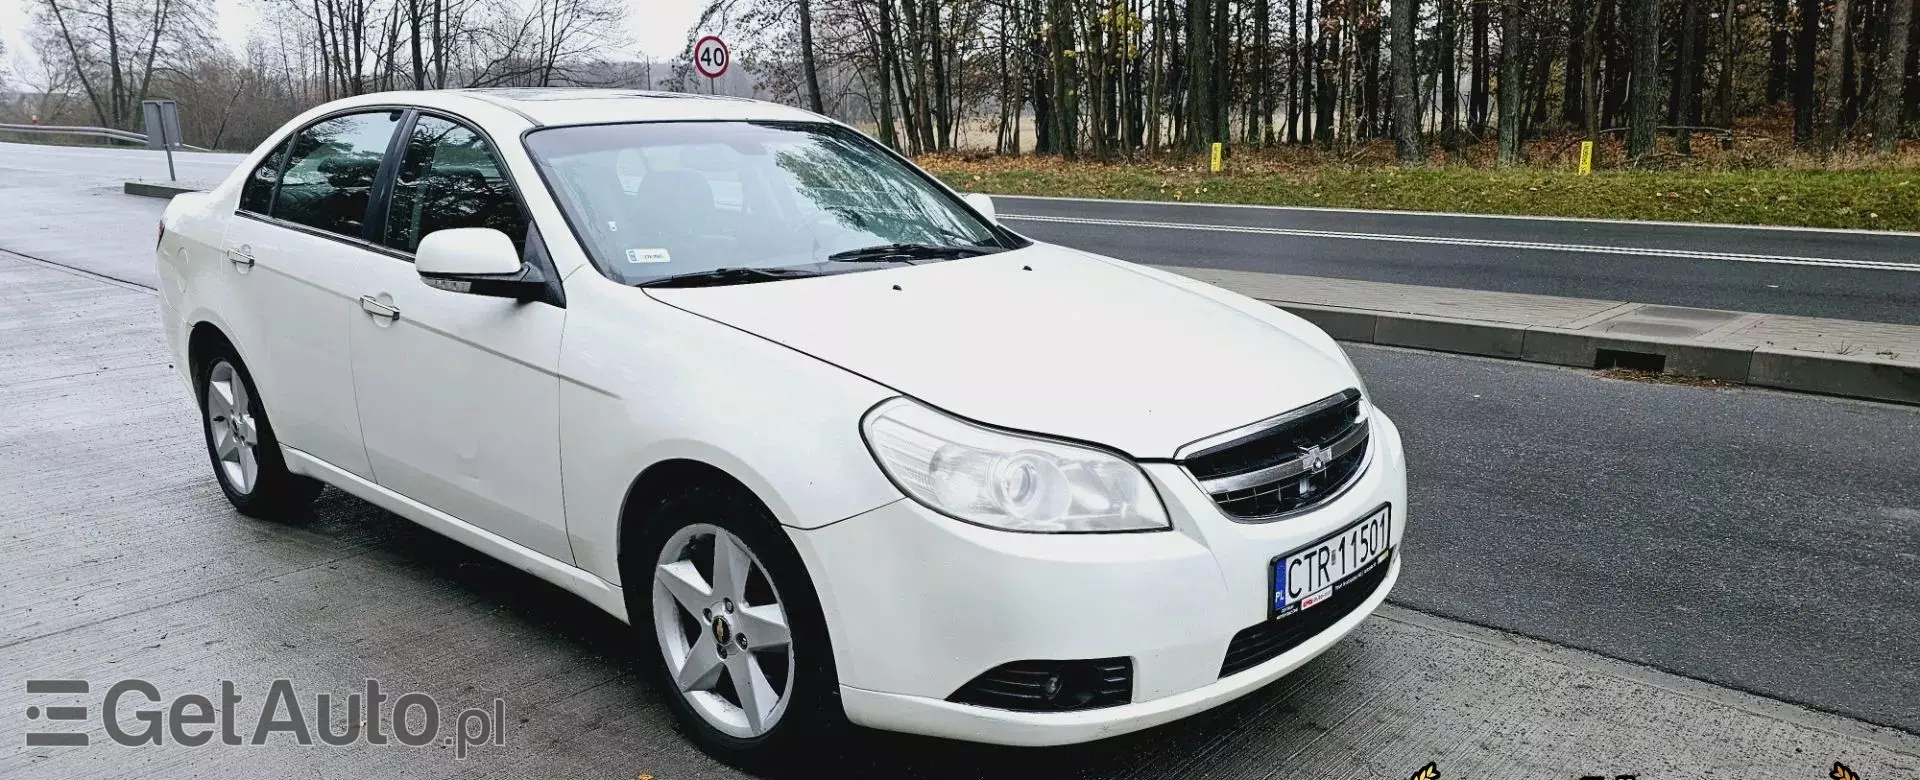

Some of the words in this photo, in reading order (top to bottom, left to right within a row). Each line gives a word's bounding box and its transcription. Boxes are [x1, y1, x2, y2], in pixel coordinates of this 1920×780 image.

[701, 47, 724, 66] 40
[1288, 545, 1330, 598] CTR
[1338, 513, 1385, 575] 11501
[1275, 590, 1285, 603] PL
